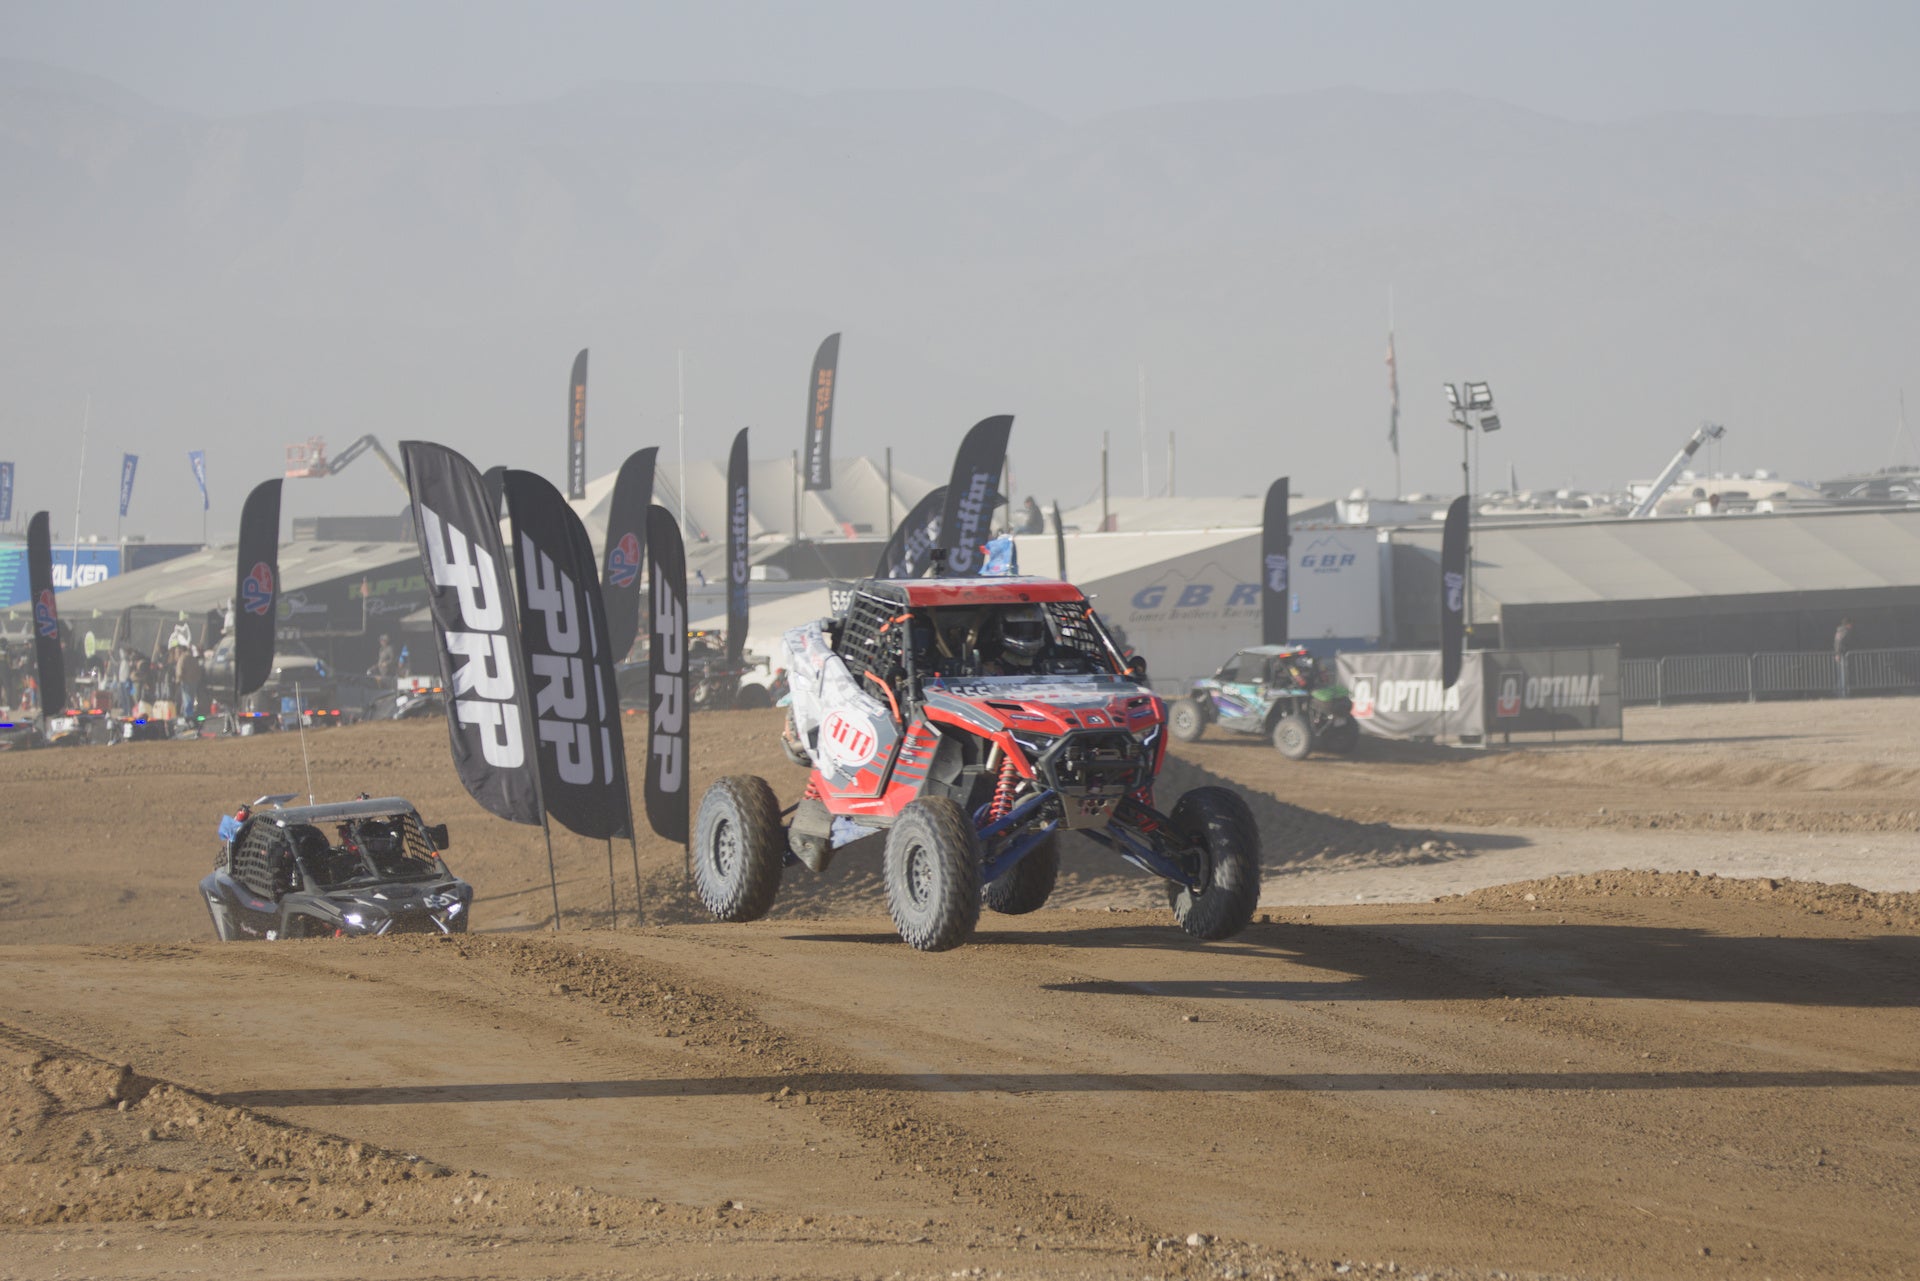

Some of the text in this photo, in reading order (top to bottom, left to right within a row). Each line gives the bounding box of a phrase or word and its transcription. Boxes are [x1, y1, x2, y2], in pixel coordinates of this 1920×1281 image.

[732, 486, 746, 584] Griffin
[949, 473, 988, 573] Griffin
[52, 564, 108, 588] ALKEN
[420, 503, 524, 768] PRP
[1378, 679, 1460, 712] OPTIMA
[1525, 675, 1600, 709] OPTIMA
